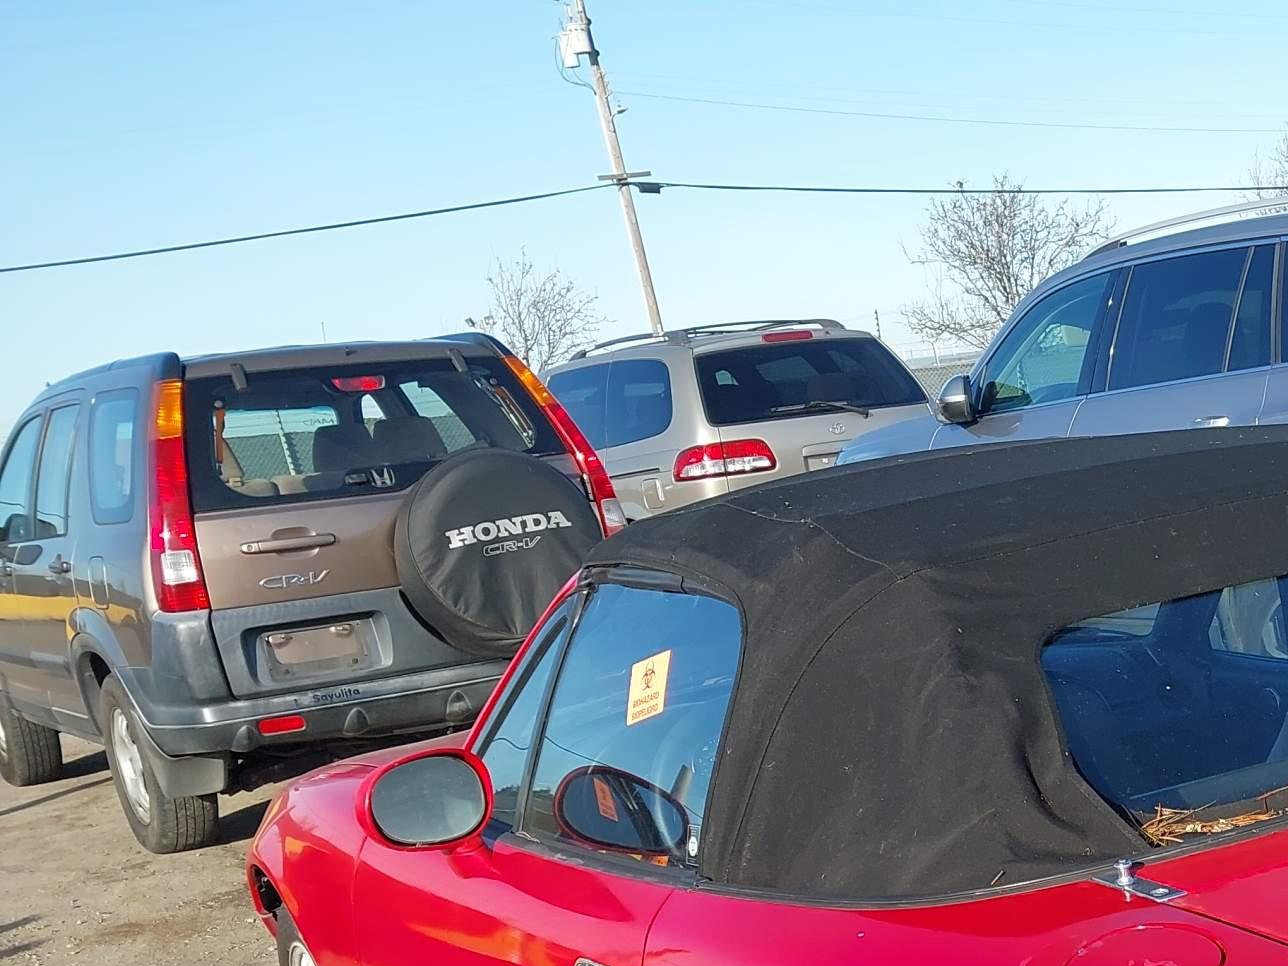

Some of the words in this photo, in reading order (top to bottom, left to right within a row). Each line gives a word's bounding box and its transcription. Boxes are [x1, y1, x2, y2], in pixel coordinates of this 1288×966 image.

[445, 510, 573, 549] HONDA
[482, 535, 542, 557] CR-V
[312, 687, 361, 704] Sayulita
